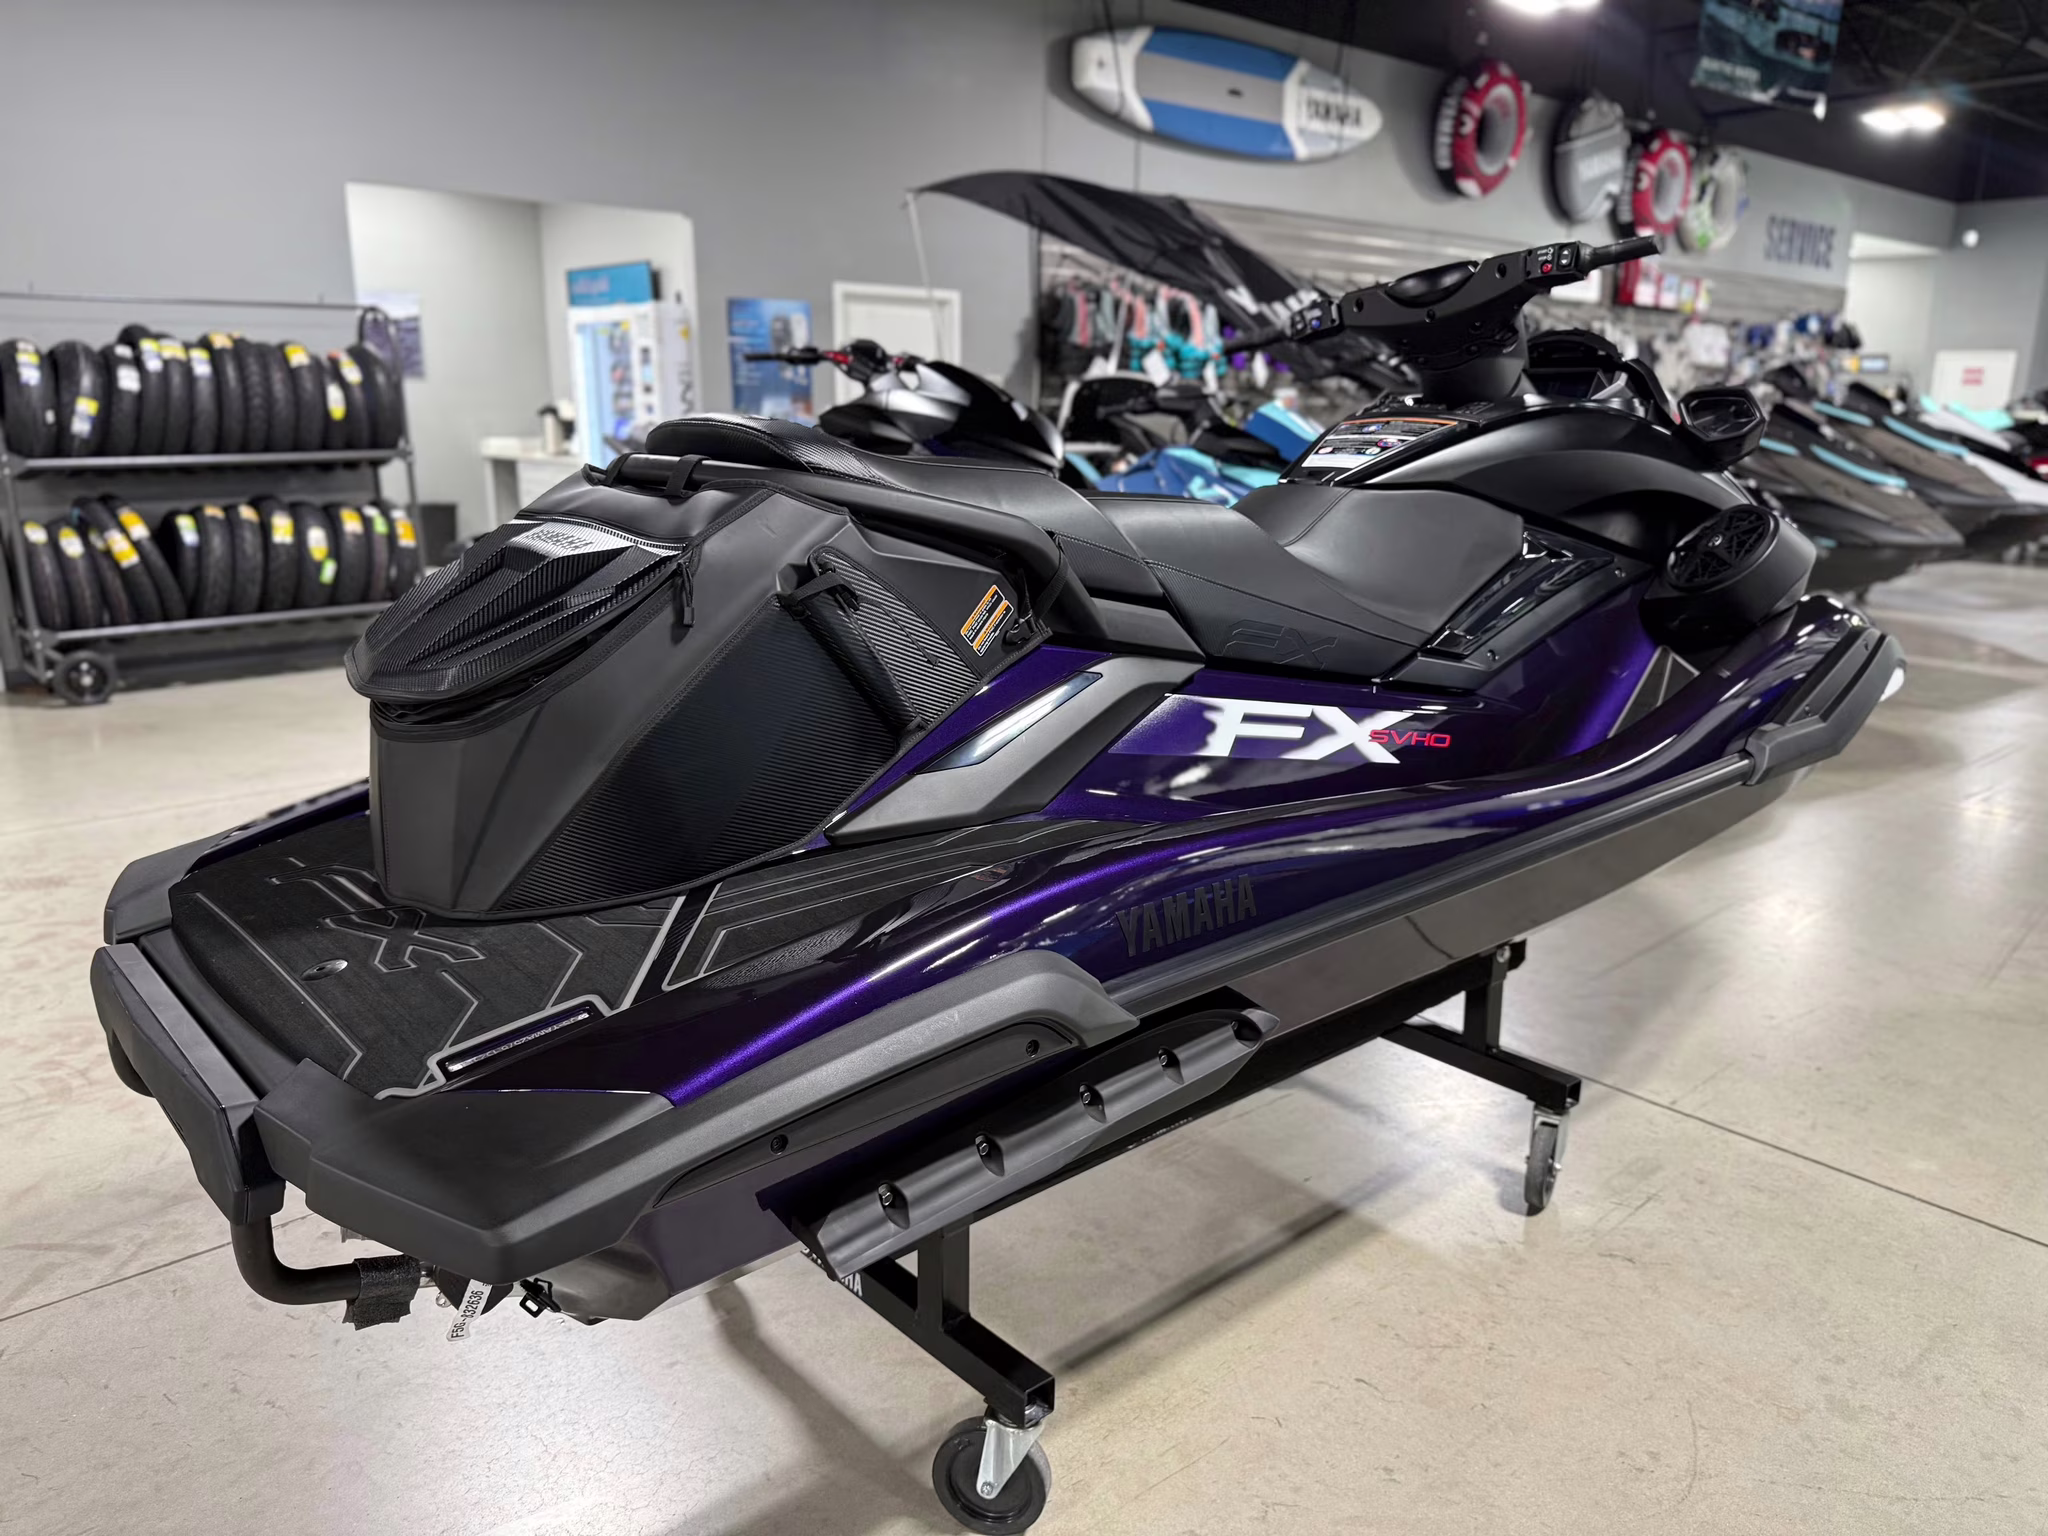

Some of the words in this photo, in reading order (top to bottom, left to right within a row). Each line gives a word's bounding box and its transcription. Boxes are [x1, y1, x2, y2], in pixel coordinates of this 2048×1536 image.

[1763, 214, 1836, 269] SERVICE
[1219, 619, 1340, 671] FX
[1199, 699, 1414, 764] FX
[1368, 729, 1451, 748] SVHO
[1115, 873, 1257, 958] YAMAHA
